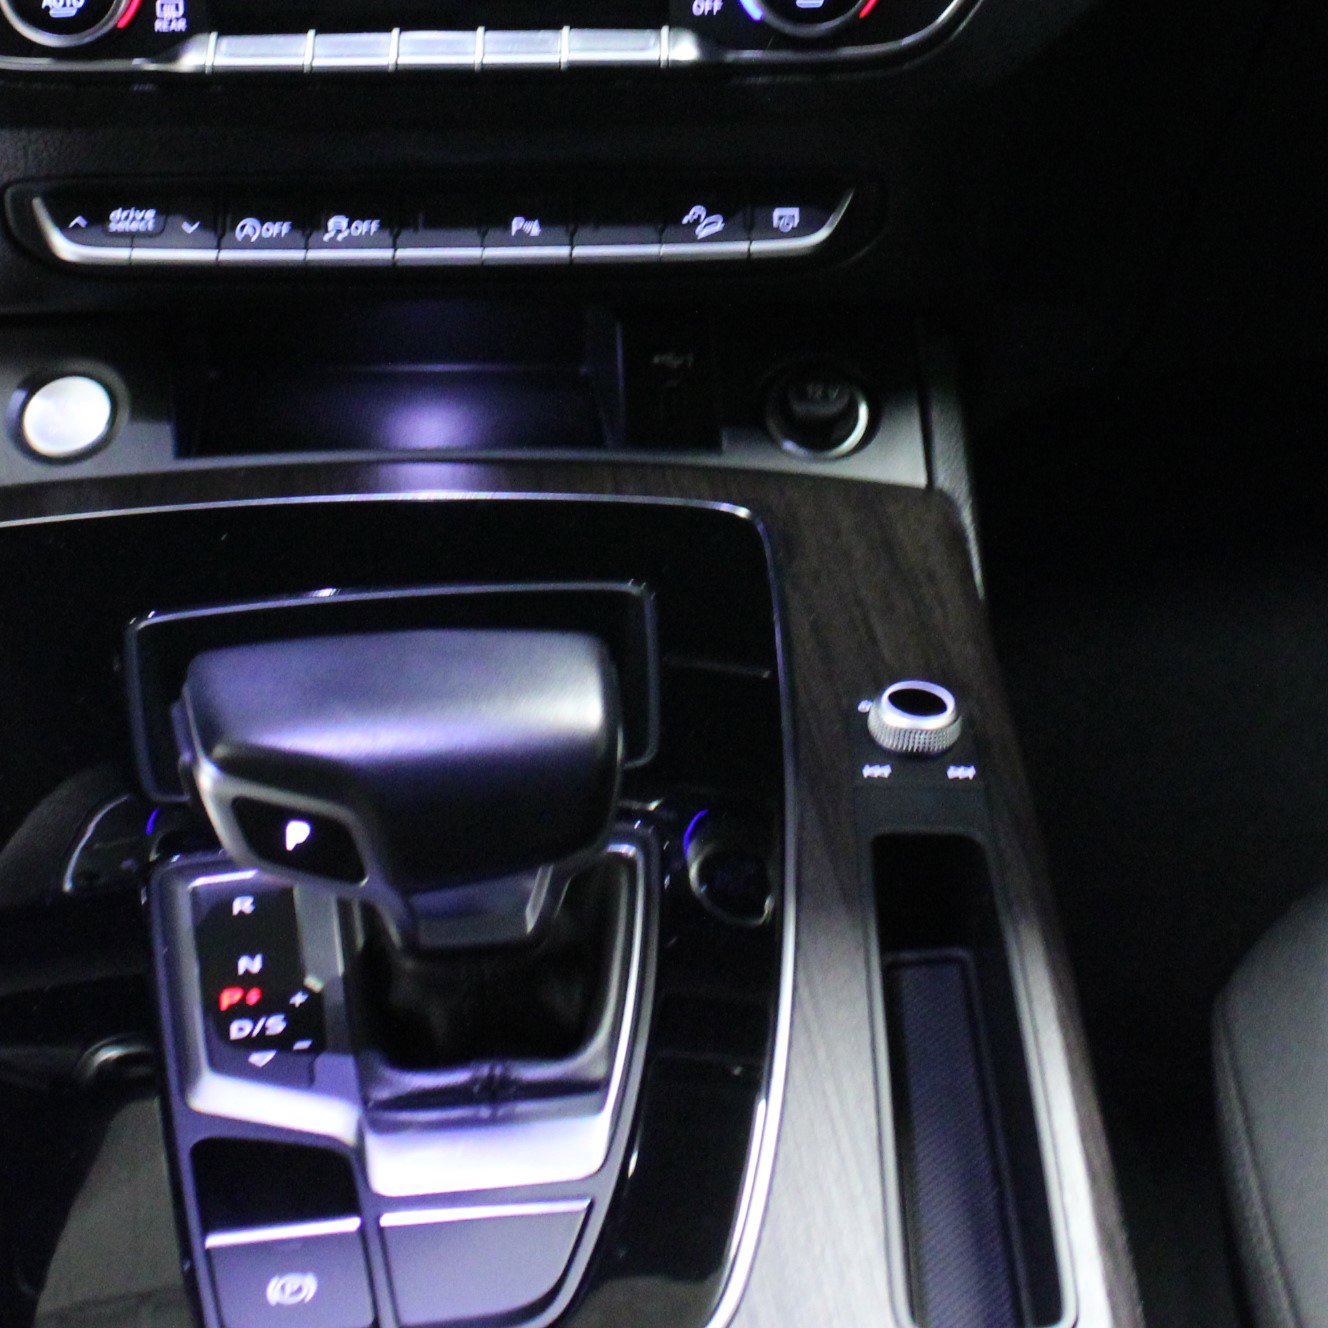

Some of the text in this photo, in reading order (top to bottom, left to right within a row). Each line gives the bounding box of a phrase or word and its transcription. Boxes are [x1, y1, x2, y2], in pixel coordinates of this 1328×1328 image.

[154, 17, 187, 33] REAR
[109, 207, 157, 221] drive
[261, 221, 293, 238] OFF
[349, 219, 381, 236] OFF
[285, 820, 311, 852] P
[232, 894, 256, 917] R
[238, 953, 264, 977] N
[229, 1013, 288, 1041] D/S
